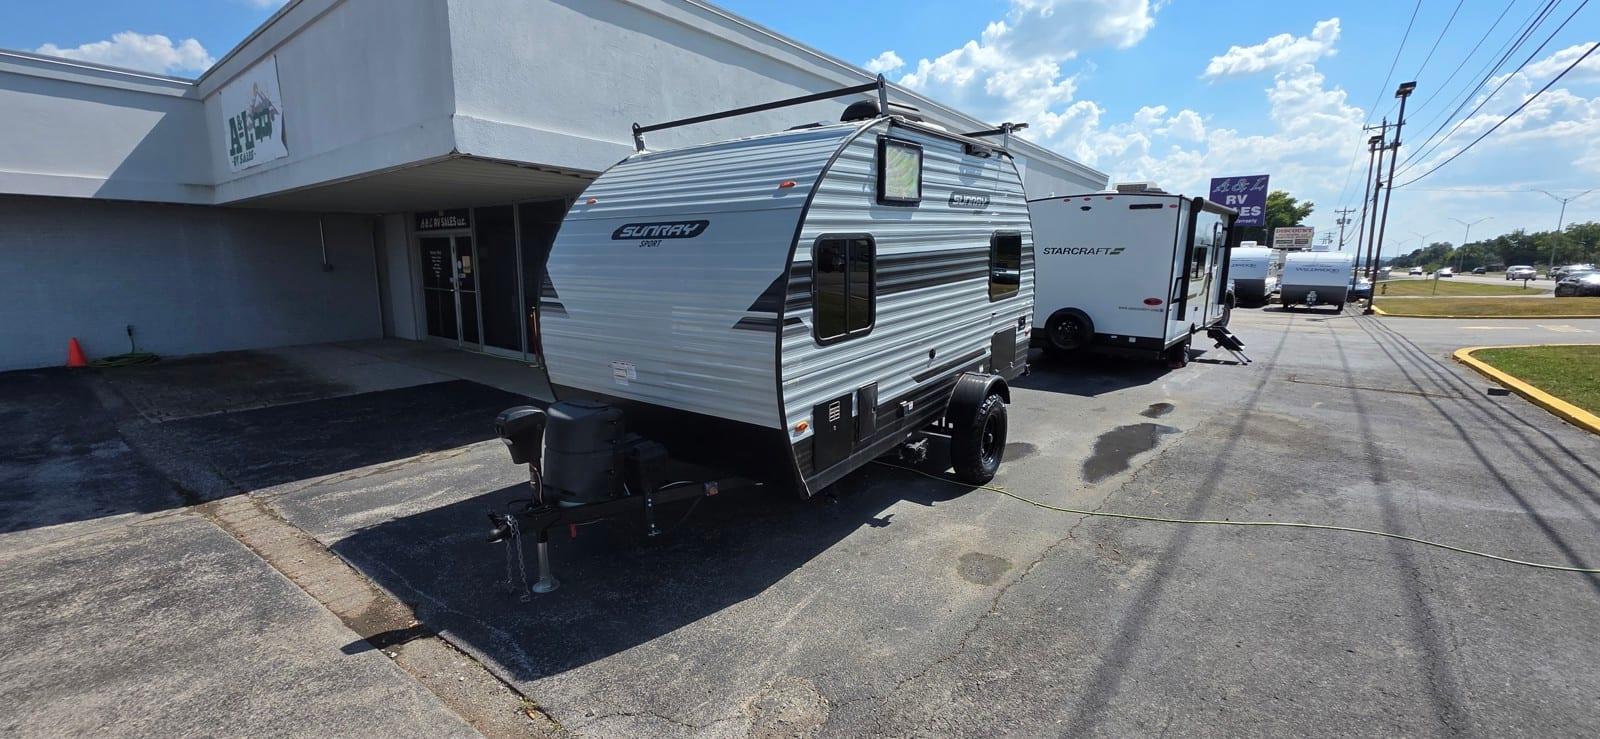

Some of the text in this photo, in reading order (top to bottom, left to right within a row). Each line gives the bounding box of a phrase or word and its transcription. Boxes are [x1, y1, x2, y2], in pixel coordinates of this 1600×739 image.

[953, 194, 988, 205] SUNRAY
[1225, 194, 1248, 205] RV
[441, 215, 457, 226] SALES
[619, 223, 700, 237] SUNRAY
[639, 239, 663, 248] SPORT
[1042, 247, 1112, 255] STARCRAFT
